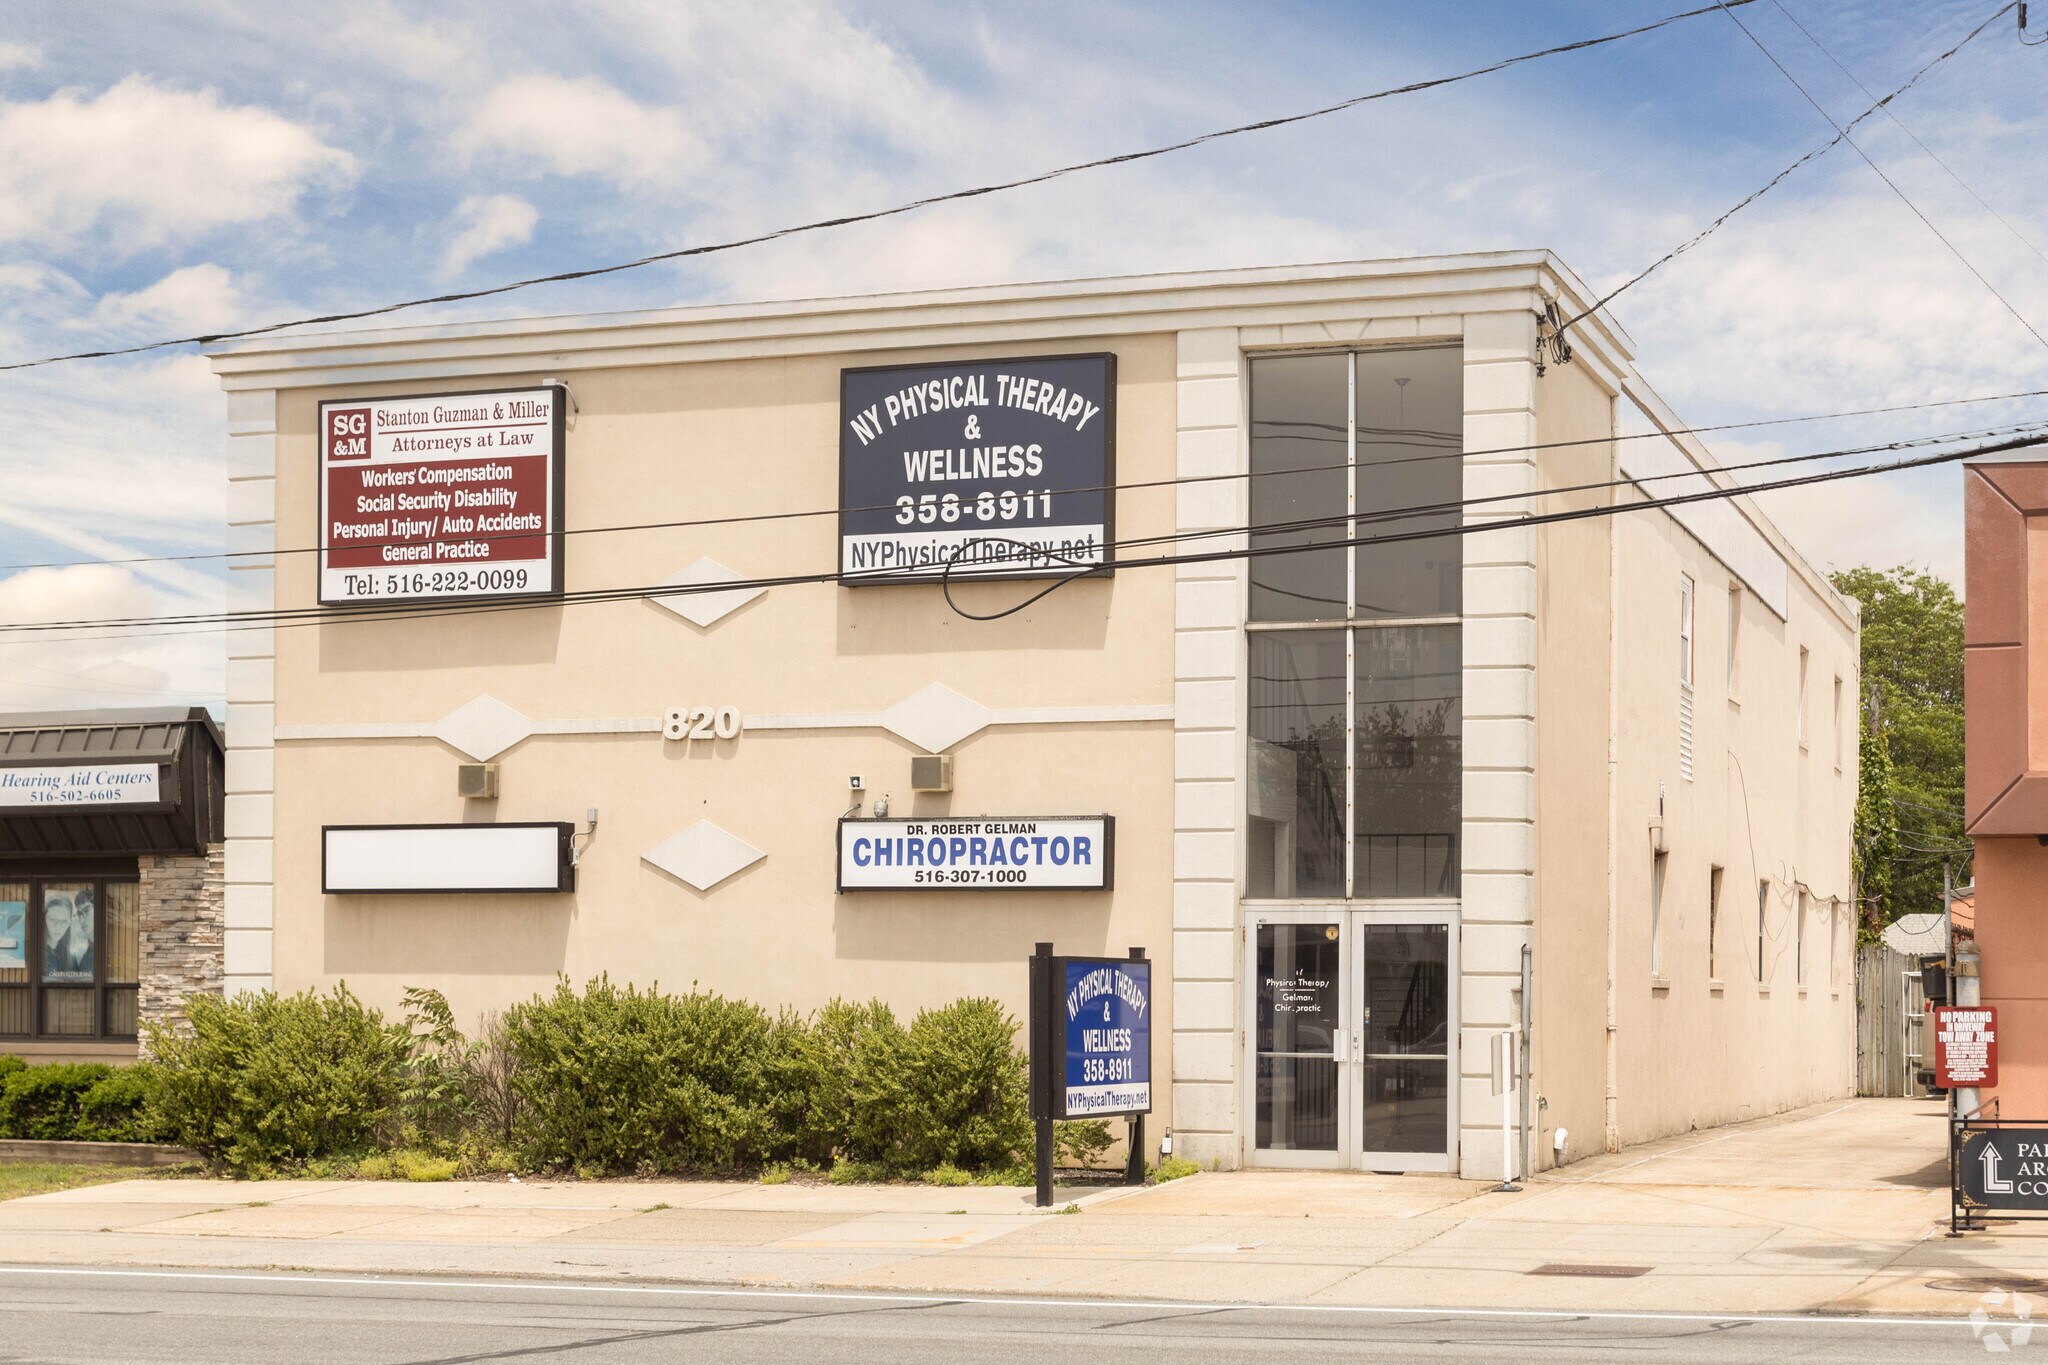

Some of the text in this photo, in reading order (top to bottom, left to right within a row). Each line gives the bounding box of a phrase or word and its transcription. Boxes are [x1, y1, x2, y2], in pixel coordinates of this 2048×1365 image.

[377, 401, 549, 427] Stanton Guzman & Miller
[850, 374, 1100, 446] NY PHYSICAL THERAPY
[333, 414, 367, 436] SG
[964, 414, 981, 440] &
[333, 438, 367, 456] &M
[392, 431, 534, 453] Attorneys at Law
[417, 462, 513, 487] Compensation
[903, 444, 1043, 482] WELLNESS
[357, 488, 517, 513] Social Security Disability
[895, 489, 1051, 525] 358-8911
[333, 518, 388, 539] Personal
[442, 515, 474, 534] Auto
[477, 512, 542, 532] Accidents
[382, 540, 489, 562] General Practice
[344, 569, 528, 596] Tel: 516-222-0099
[663, 705, 741, 740] 820
[1, 770, 152, 790] Hearing Aid Centers
[30, 789, 122, 803] 516-502-6605
[907, 823, 1036, 835] DR. ROBERT GELMAN
[852, 836, 1091, 867] CHIROPRACTOR
[914, 870, 1027, 883] 516-307-1000
[1067, 968, 1147, 1022] NY PHYSICAL THERAPY
[1103, 1001, 1111, 1022] &
[1940, 1011, 1993, 1023] NO PARKING
[1938, 1031, 1995, 1042] TOW AWAY ZONE
[1954, 1022, 1986, 1032] DRIVEWAY
[1083, 1028, 1131, 1052] WELLNESS
[1083, 1058, 1132, 1082] 358-8911
